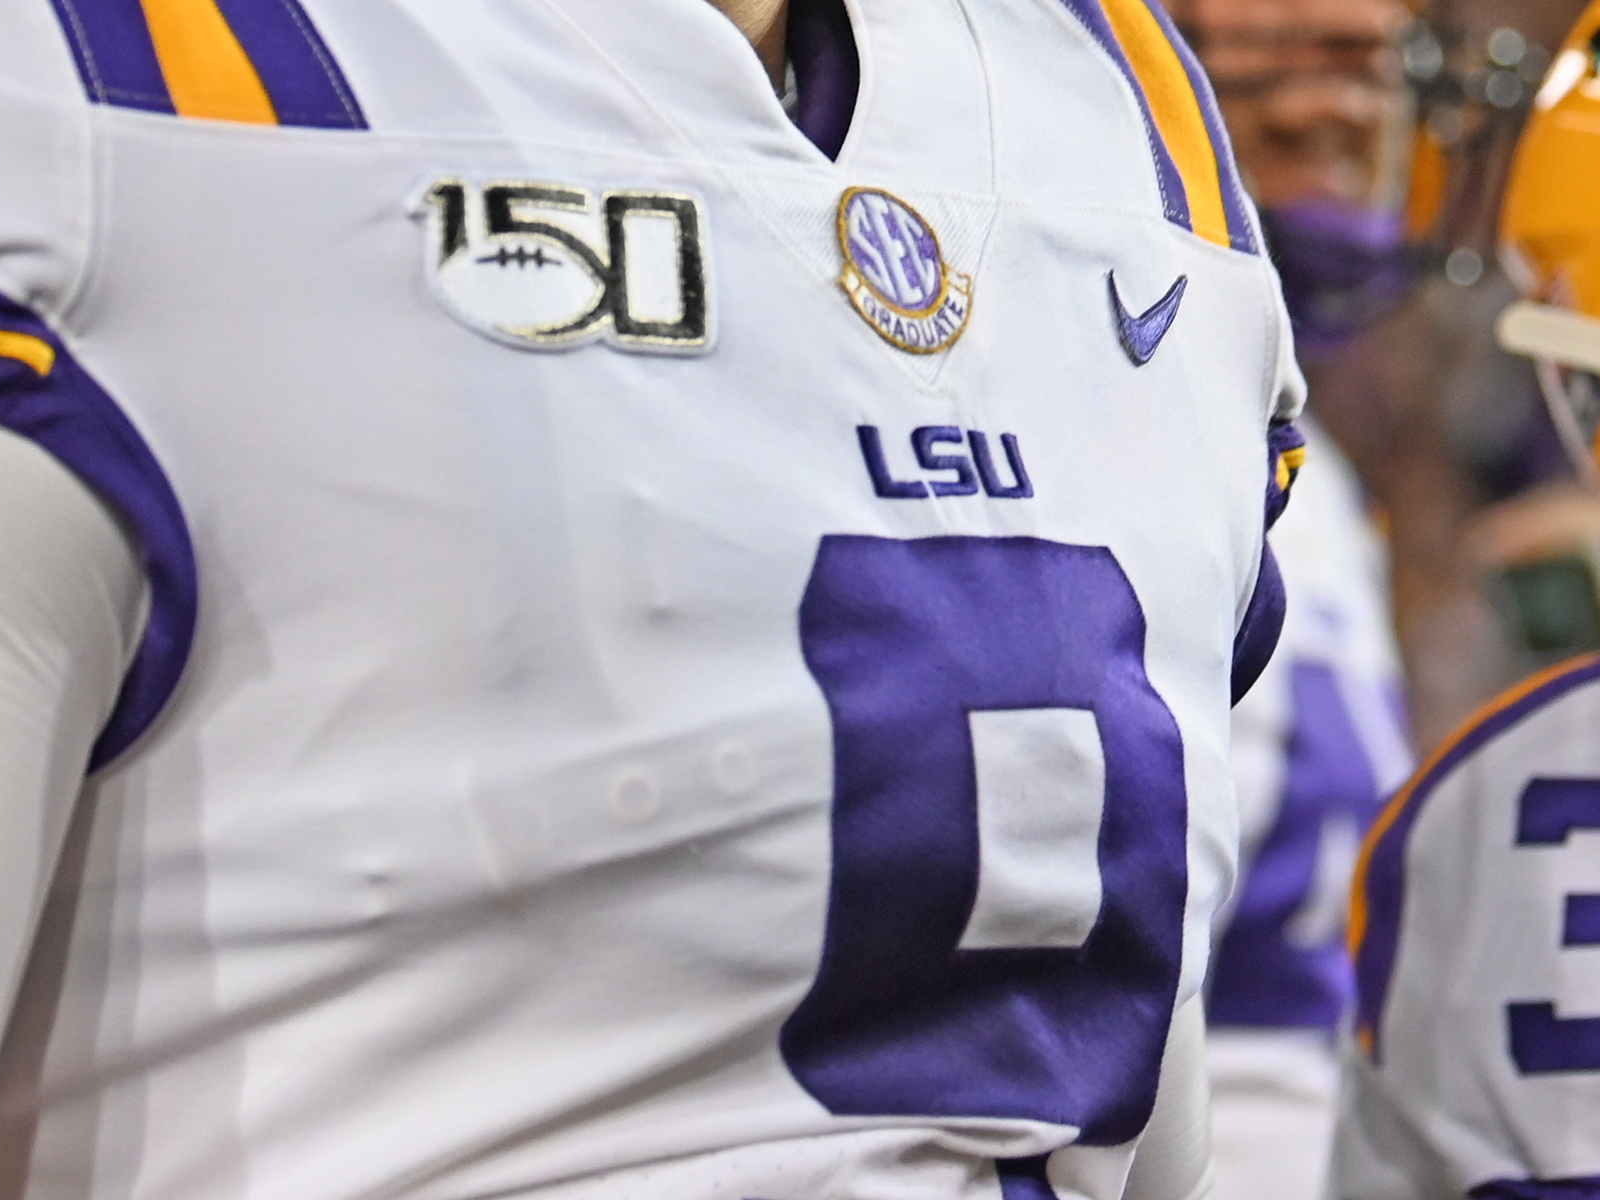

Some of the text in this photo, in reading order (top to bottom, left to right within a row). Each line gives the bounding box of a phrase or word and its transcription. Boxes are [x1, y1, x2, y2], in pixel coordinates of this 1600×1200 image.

[423, 176, 708, 346] 150
[847, 192, 937, 305] SEC
[862, 297, 964, 348] GRADUATE
[856, 424, 1034, 499] LSU
